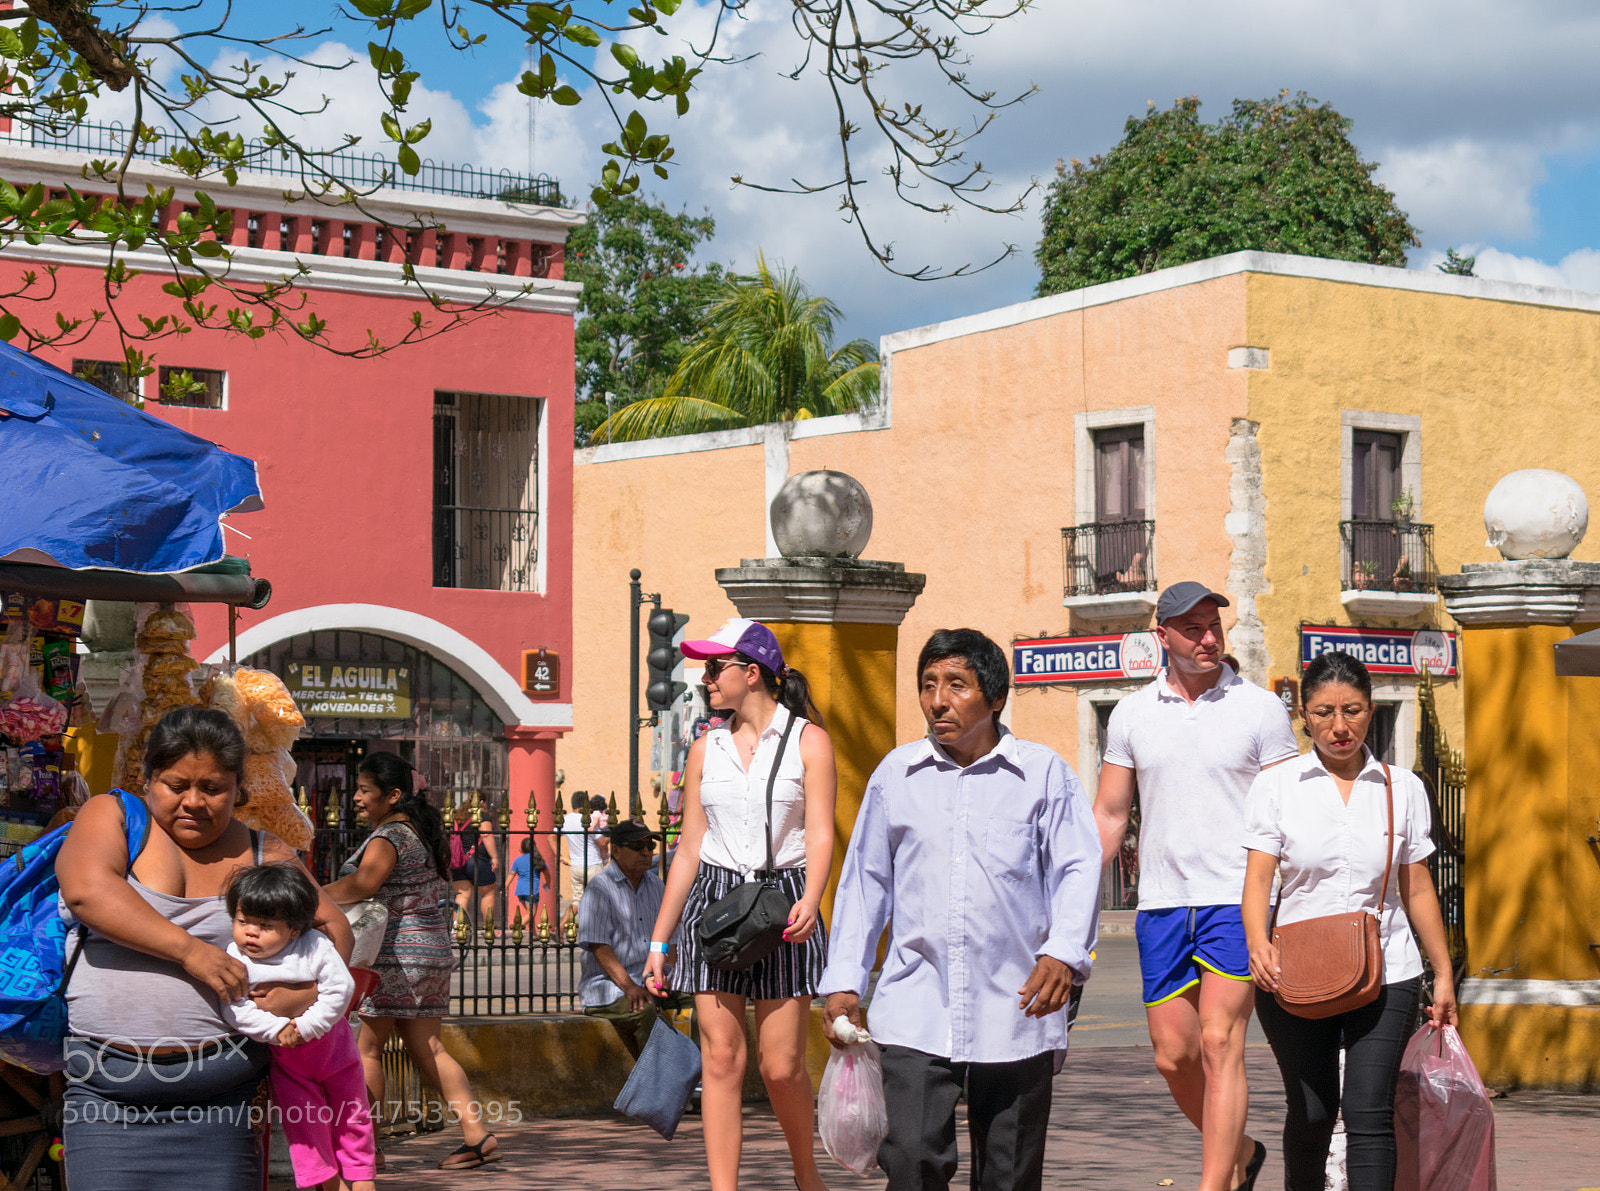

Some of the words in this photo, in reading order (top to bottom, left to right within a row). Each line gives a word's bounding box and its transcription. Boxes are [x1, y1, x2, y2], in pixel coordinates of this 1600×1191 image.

[1021, 645, 1117, 673] Farmacia
[534, 666, 550, 680] 42
[291, 690, 346, 700] MERCERIA
[359, 691, 394, 701] TELAS
[1281, 691, 1292, 703] 42
[301, 702, 308, 712] Y
[311, 702, 384, 713] NOVEDADES
